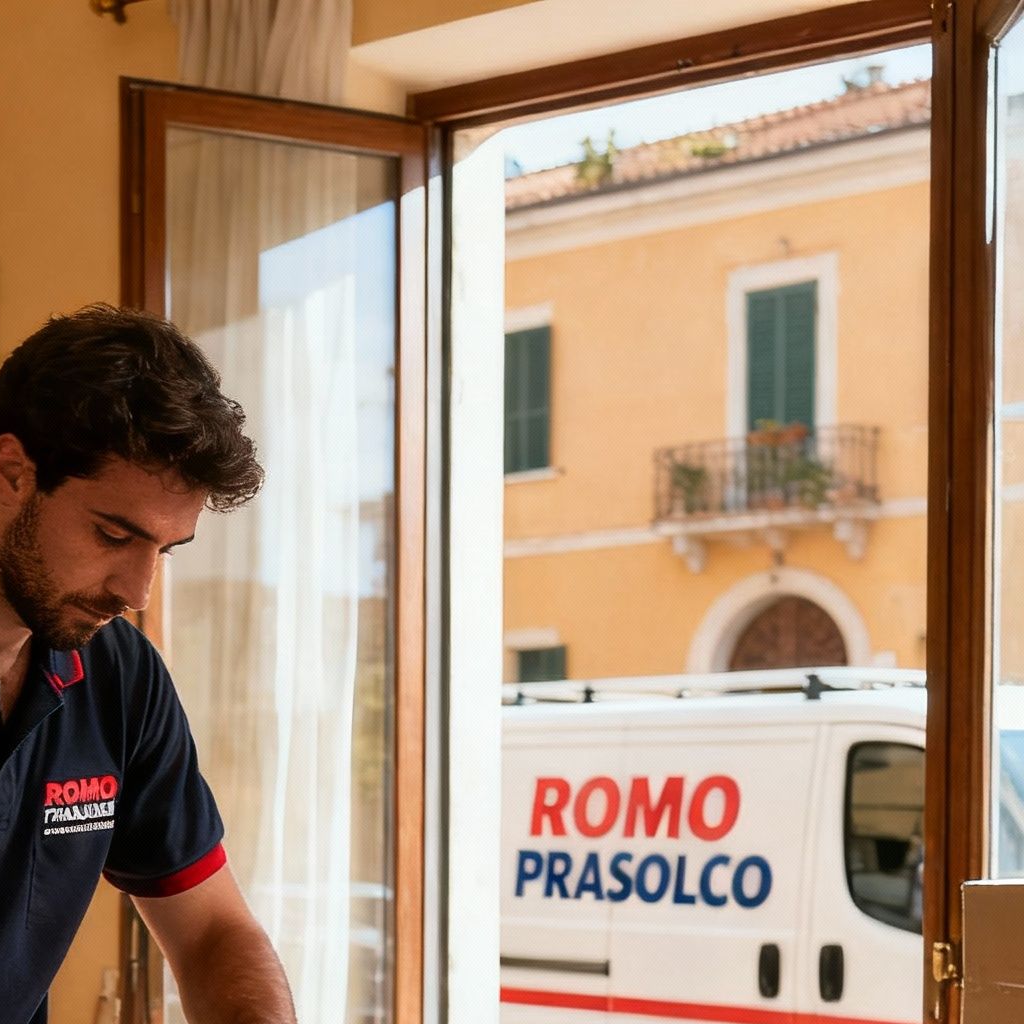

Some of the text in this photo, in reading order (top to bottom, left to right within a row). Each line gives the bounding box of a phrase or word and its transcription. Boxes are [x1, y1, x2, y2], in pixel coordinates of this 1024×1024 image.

[44, 775, 117, 807] ROMO
[529, 775, 741, 842] ROMO
[515, 850, 773, 909] PRASOLCO
